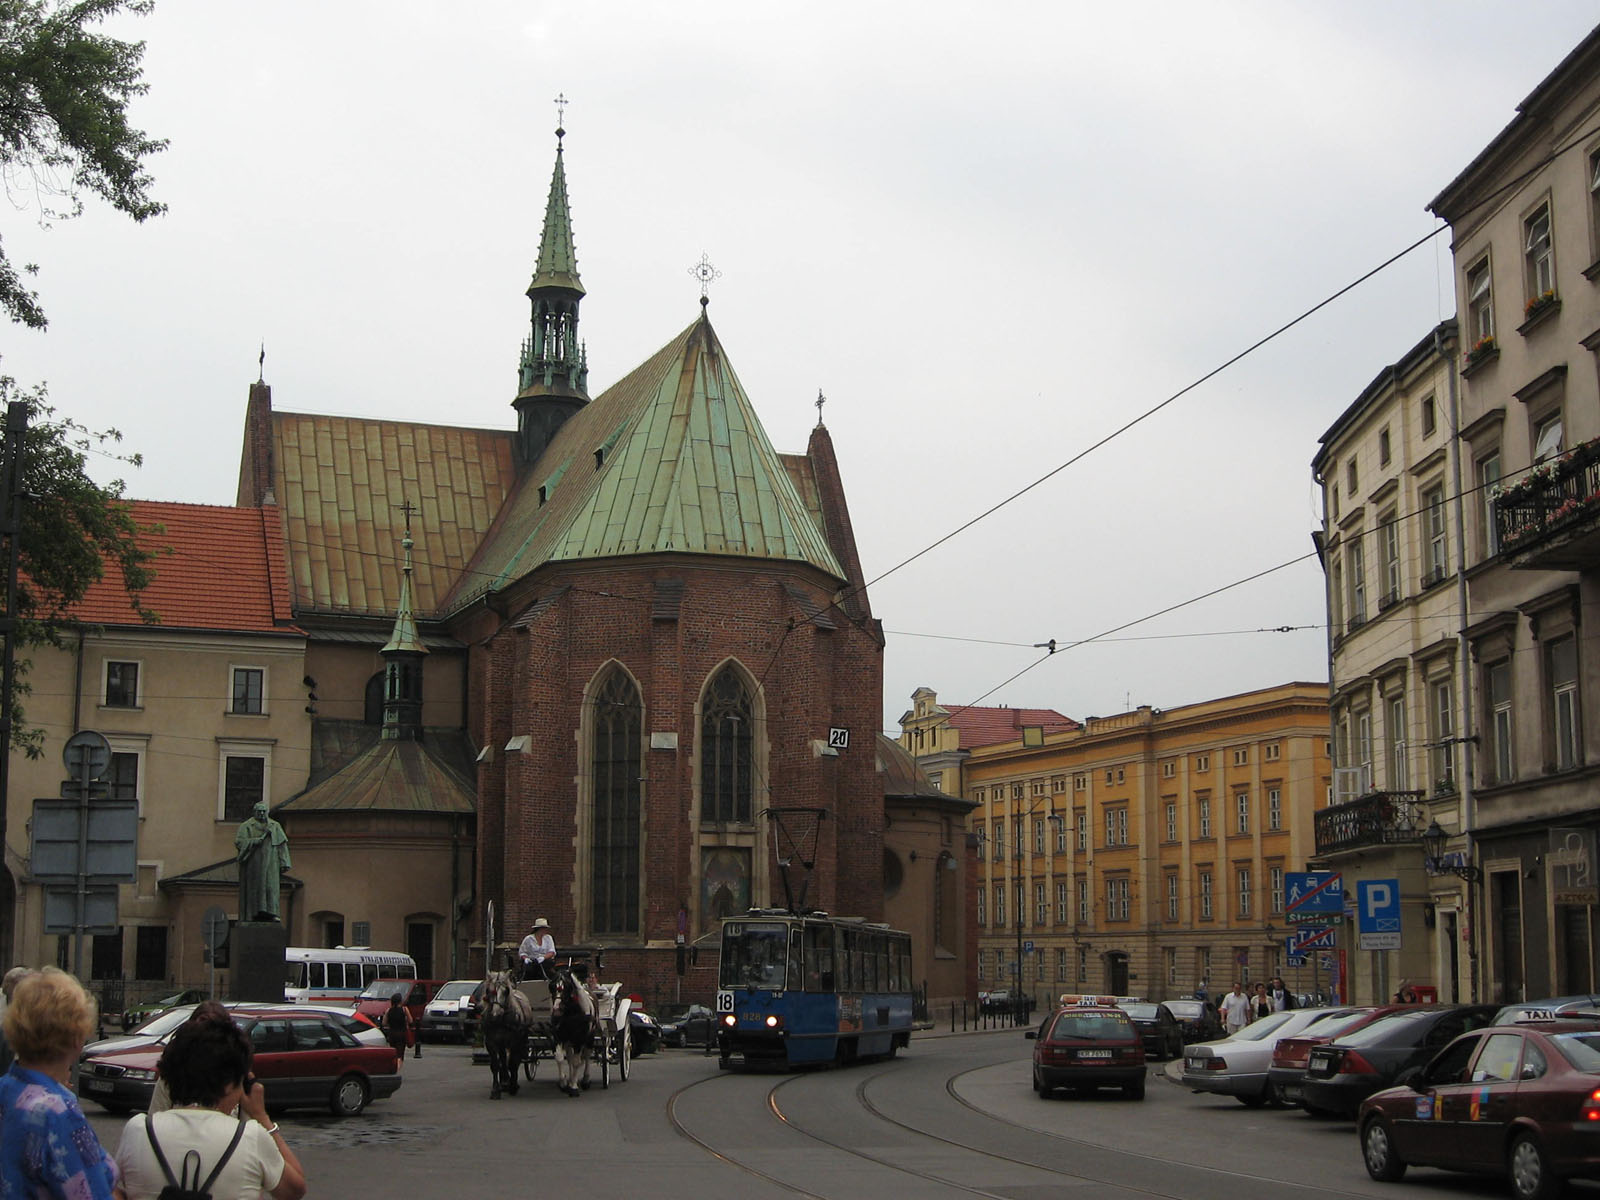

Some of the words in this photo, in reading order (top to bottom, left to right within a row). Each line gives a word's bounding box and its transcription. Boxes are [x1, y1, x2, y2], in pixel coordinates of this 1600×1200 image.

[832, 730, 846, 745] 20
[1367, 884, 1391, 918] P
[729, 924, 742, 936] 18
[1297, 930, 1334, 946] TAXI
[718, 994, 733, 1011] 18
[1525, 1011, 1553, 1020] TAXI
